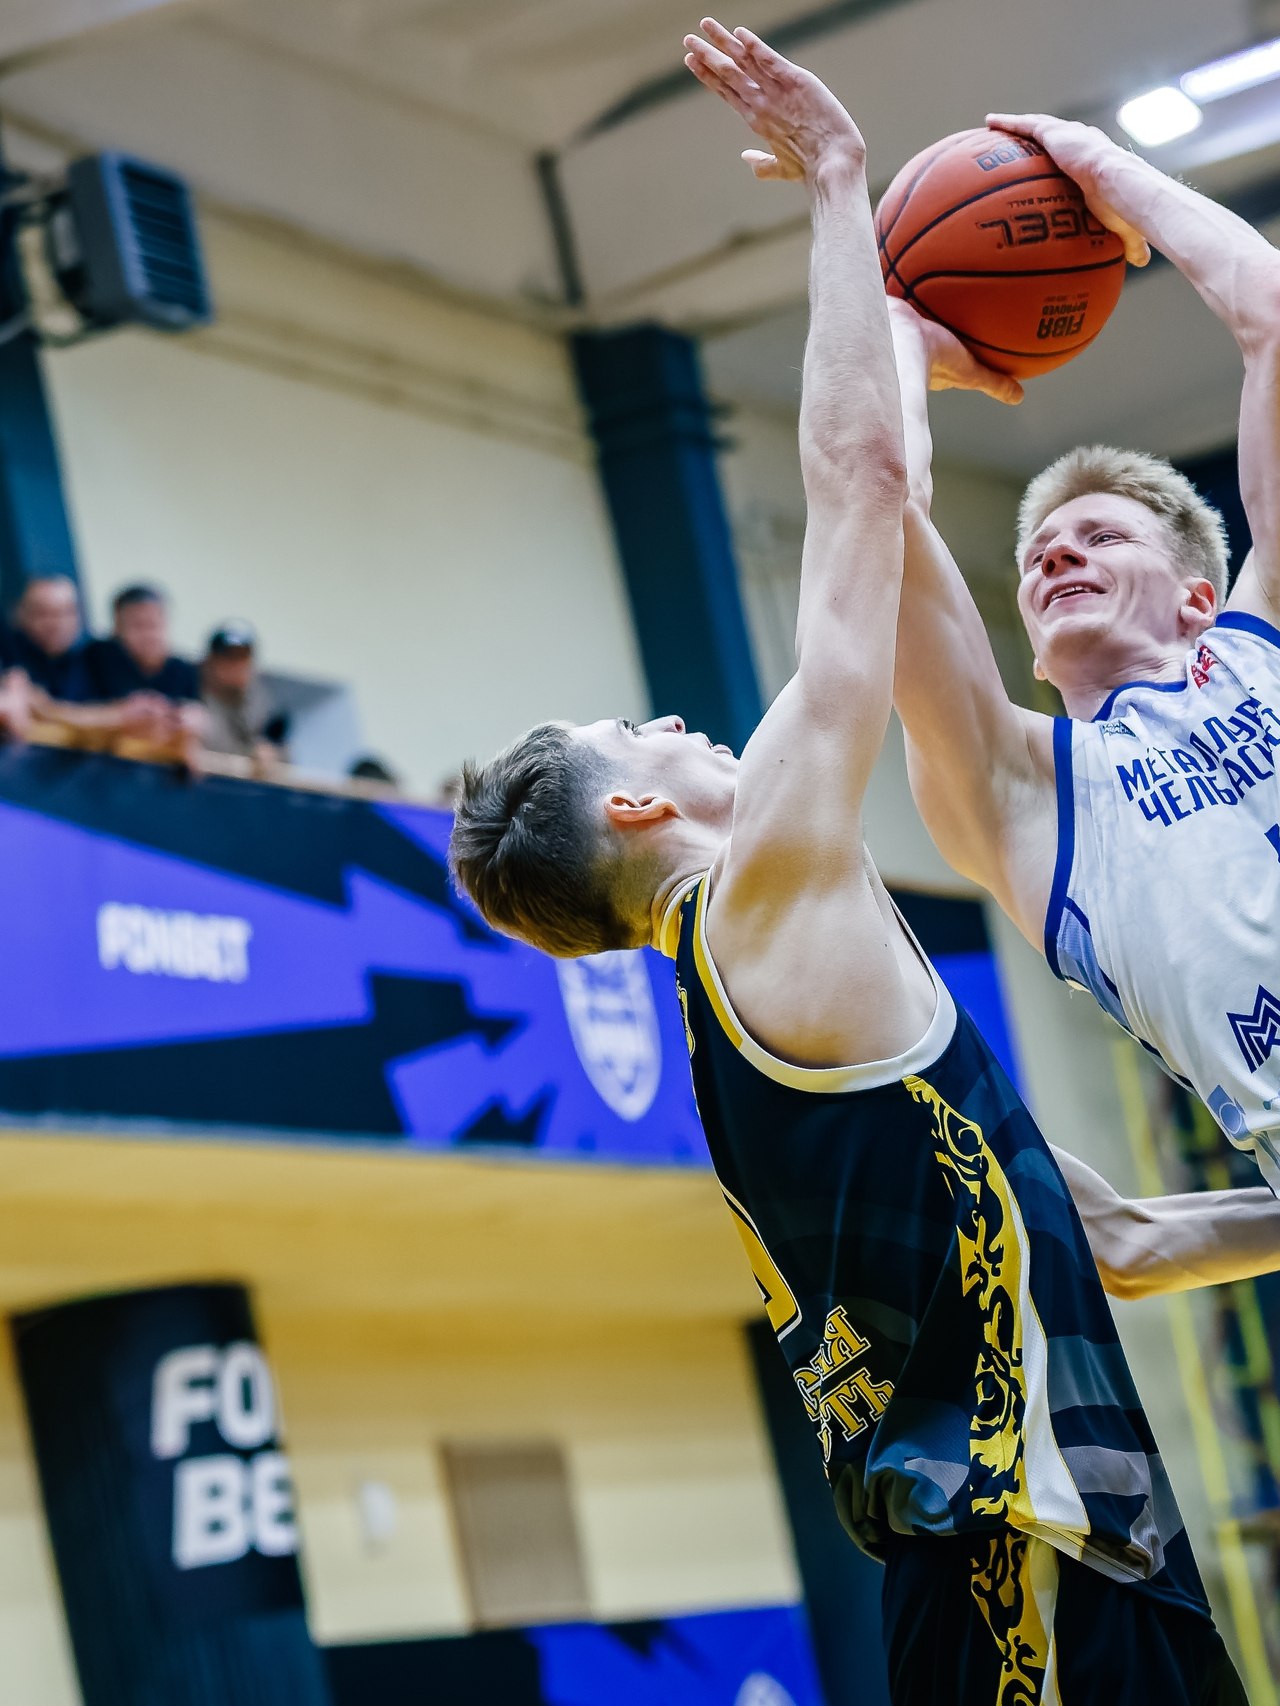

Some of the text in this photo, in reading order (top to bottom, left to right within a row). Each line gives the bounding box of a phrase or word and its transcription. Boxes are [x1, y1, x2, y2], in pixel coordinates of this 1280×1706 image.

[978, 207, 1106, 248] ÖGEL
[1037, 312, 1085, 340] FIBA
[1115, 687, 1264, 802] МЕТАЛЛУР
[151, 1341, 281, 1460] FO
[172, 1451, 300, 1571] BE
